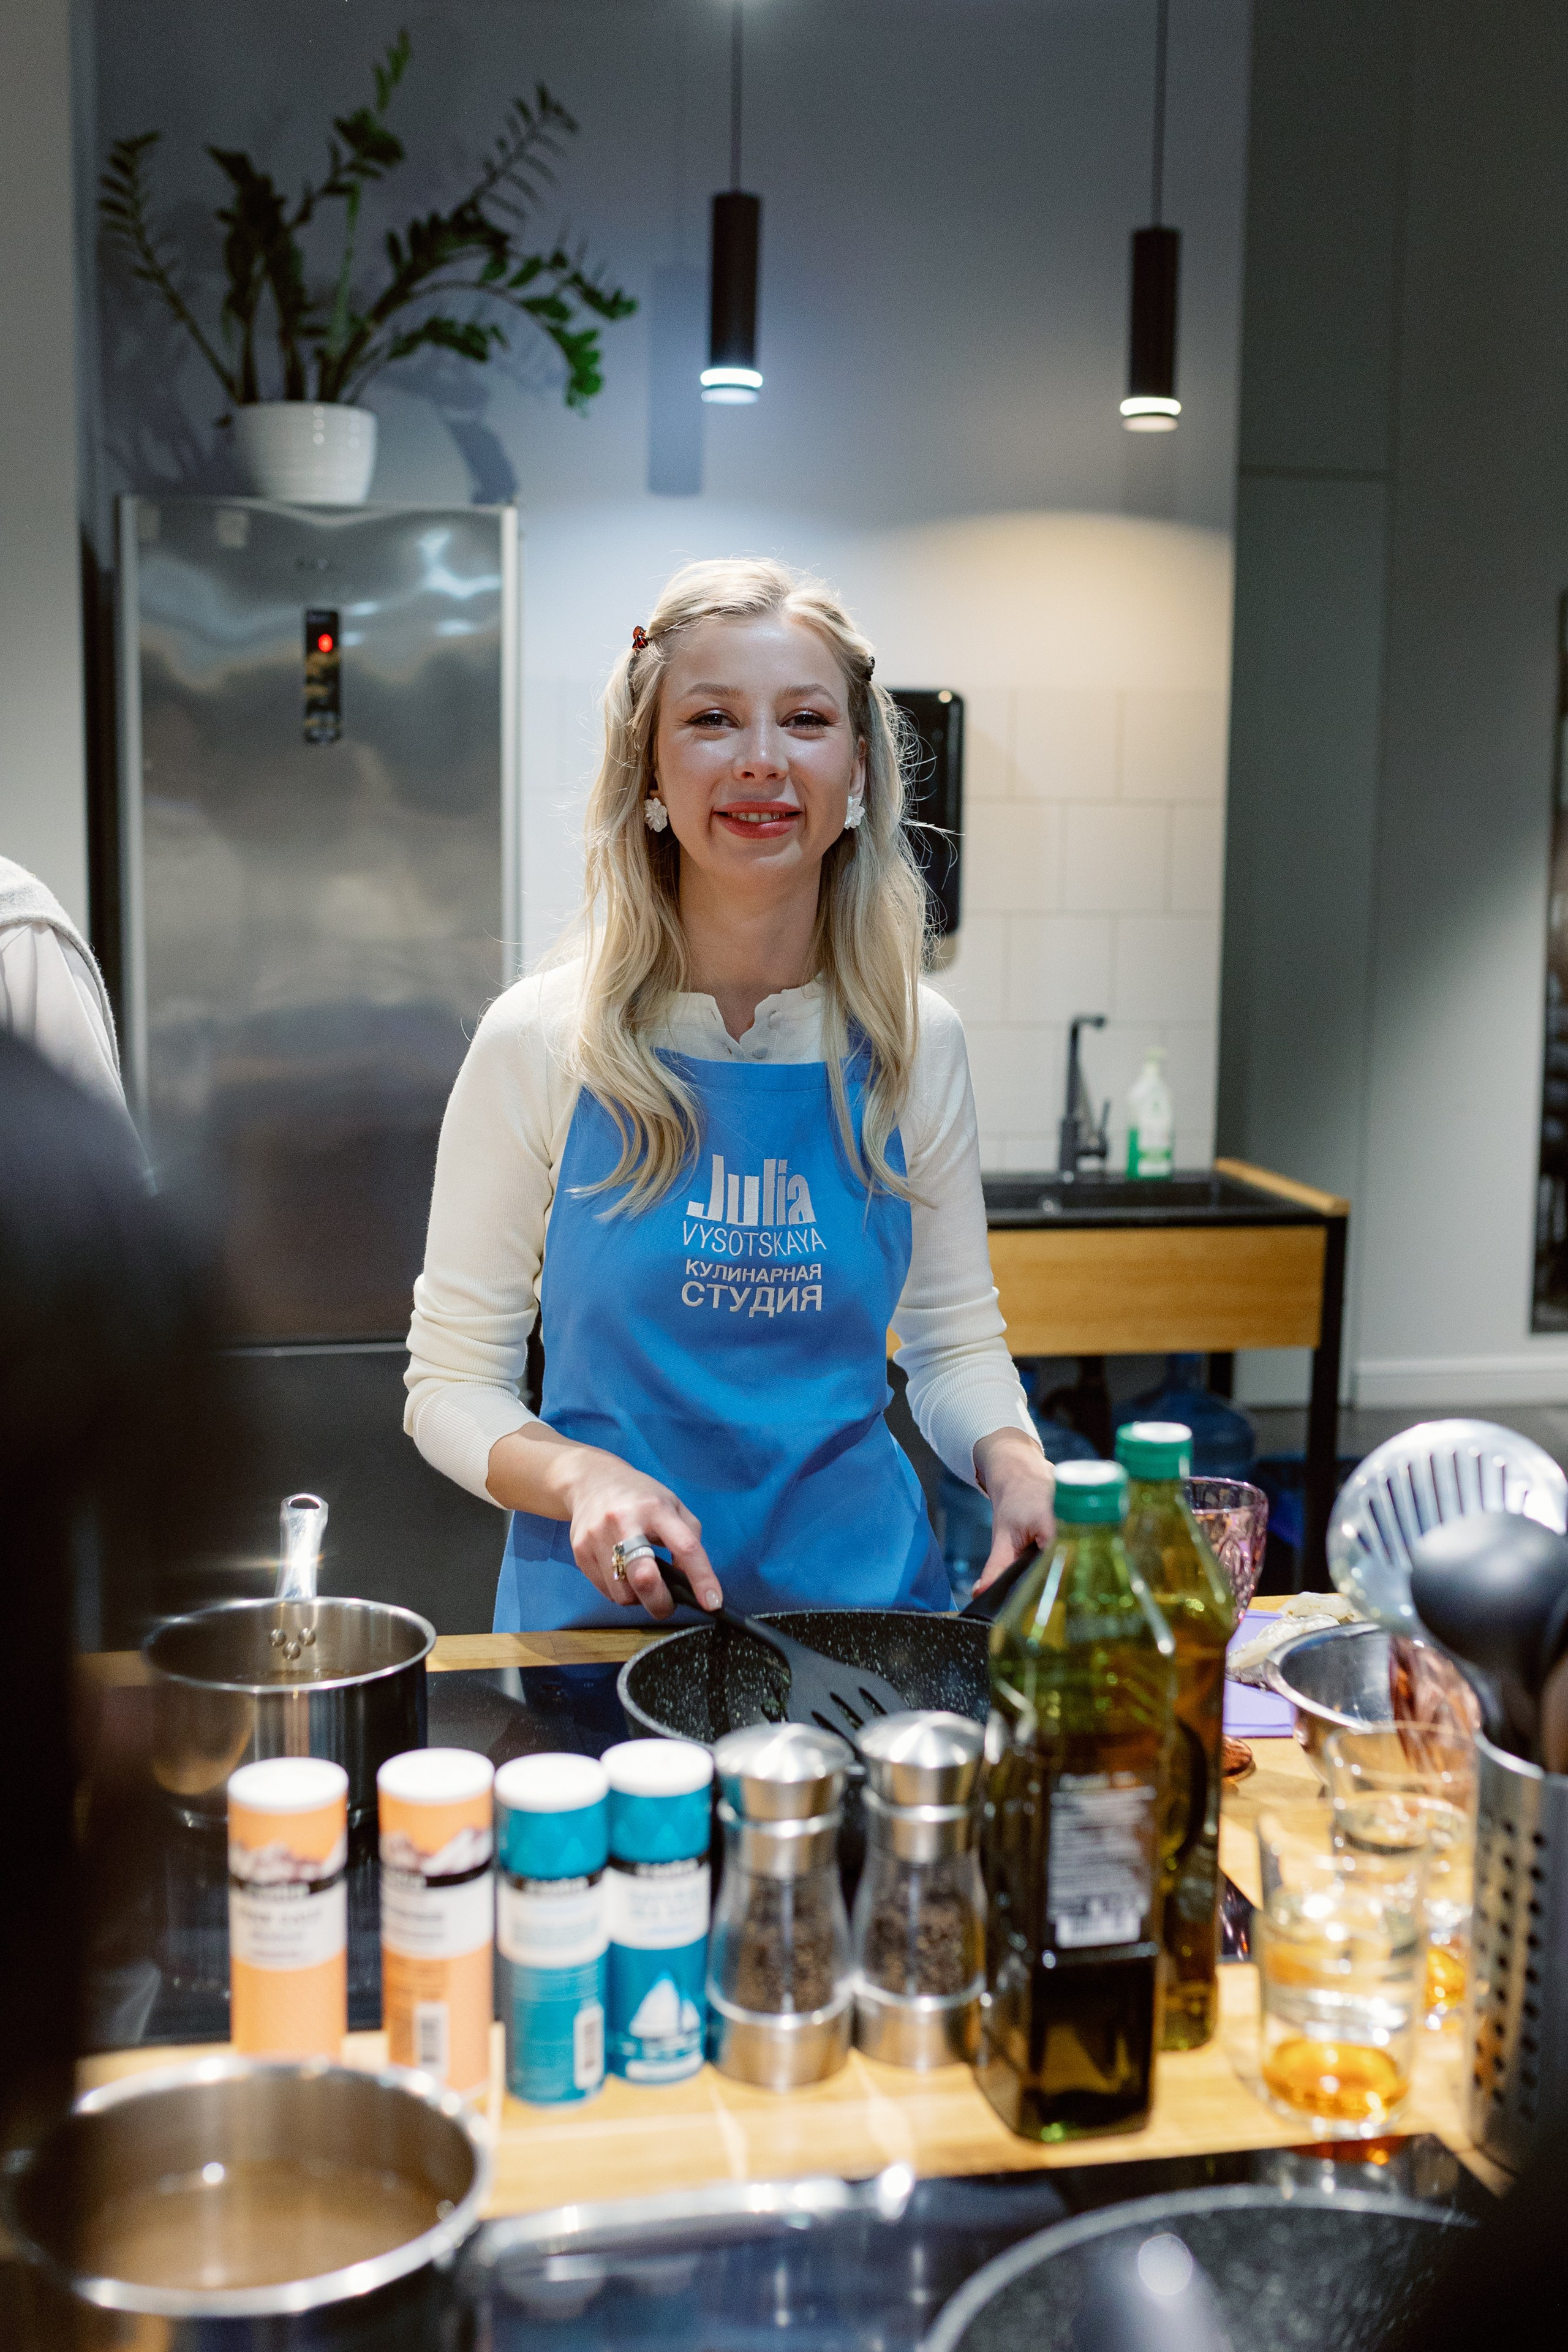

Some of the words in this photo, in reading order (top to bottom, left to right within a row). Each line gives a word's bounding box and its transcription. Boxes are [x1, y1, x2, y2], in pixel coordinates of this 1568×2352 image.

[686, 1154, 816, 1226] Julia
[683, 1220, 827, 1257] VYSOTSKAYA
[685, 1259, 822, 1283] КУЛИНАРНАЯ
[681, 1281, 823, 1318] СТУДИЯ
